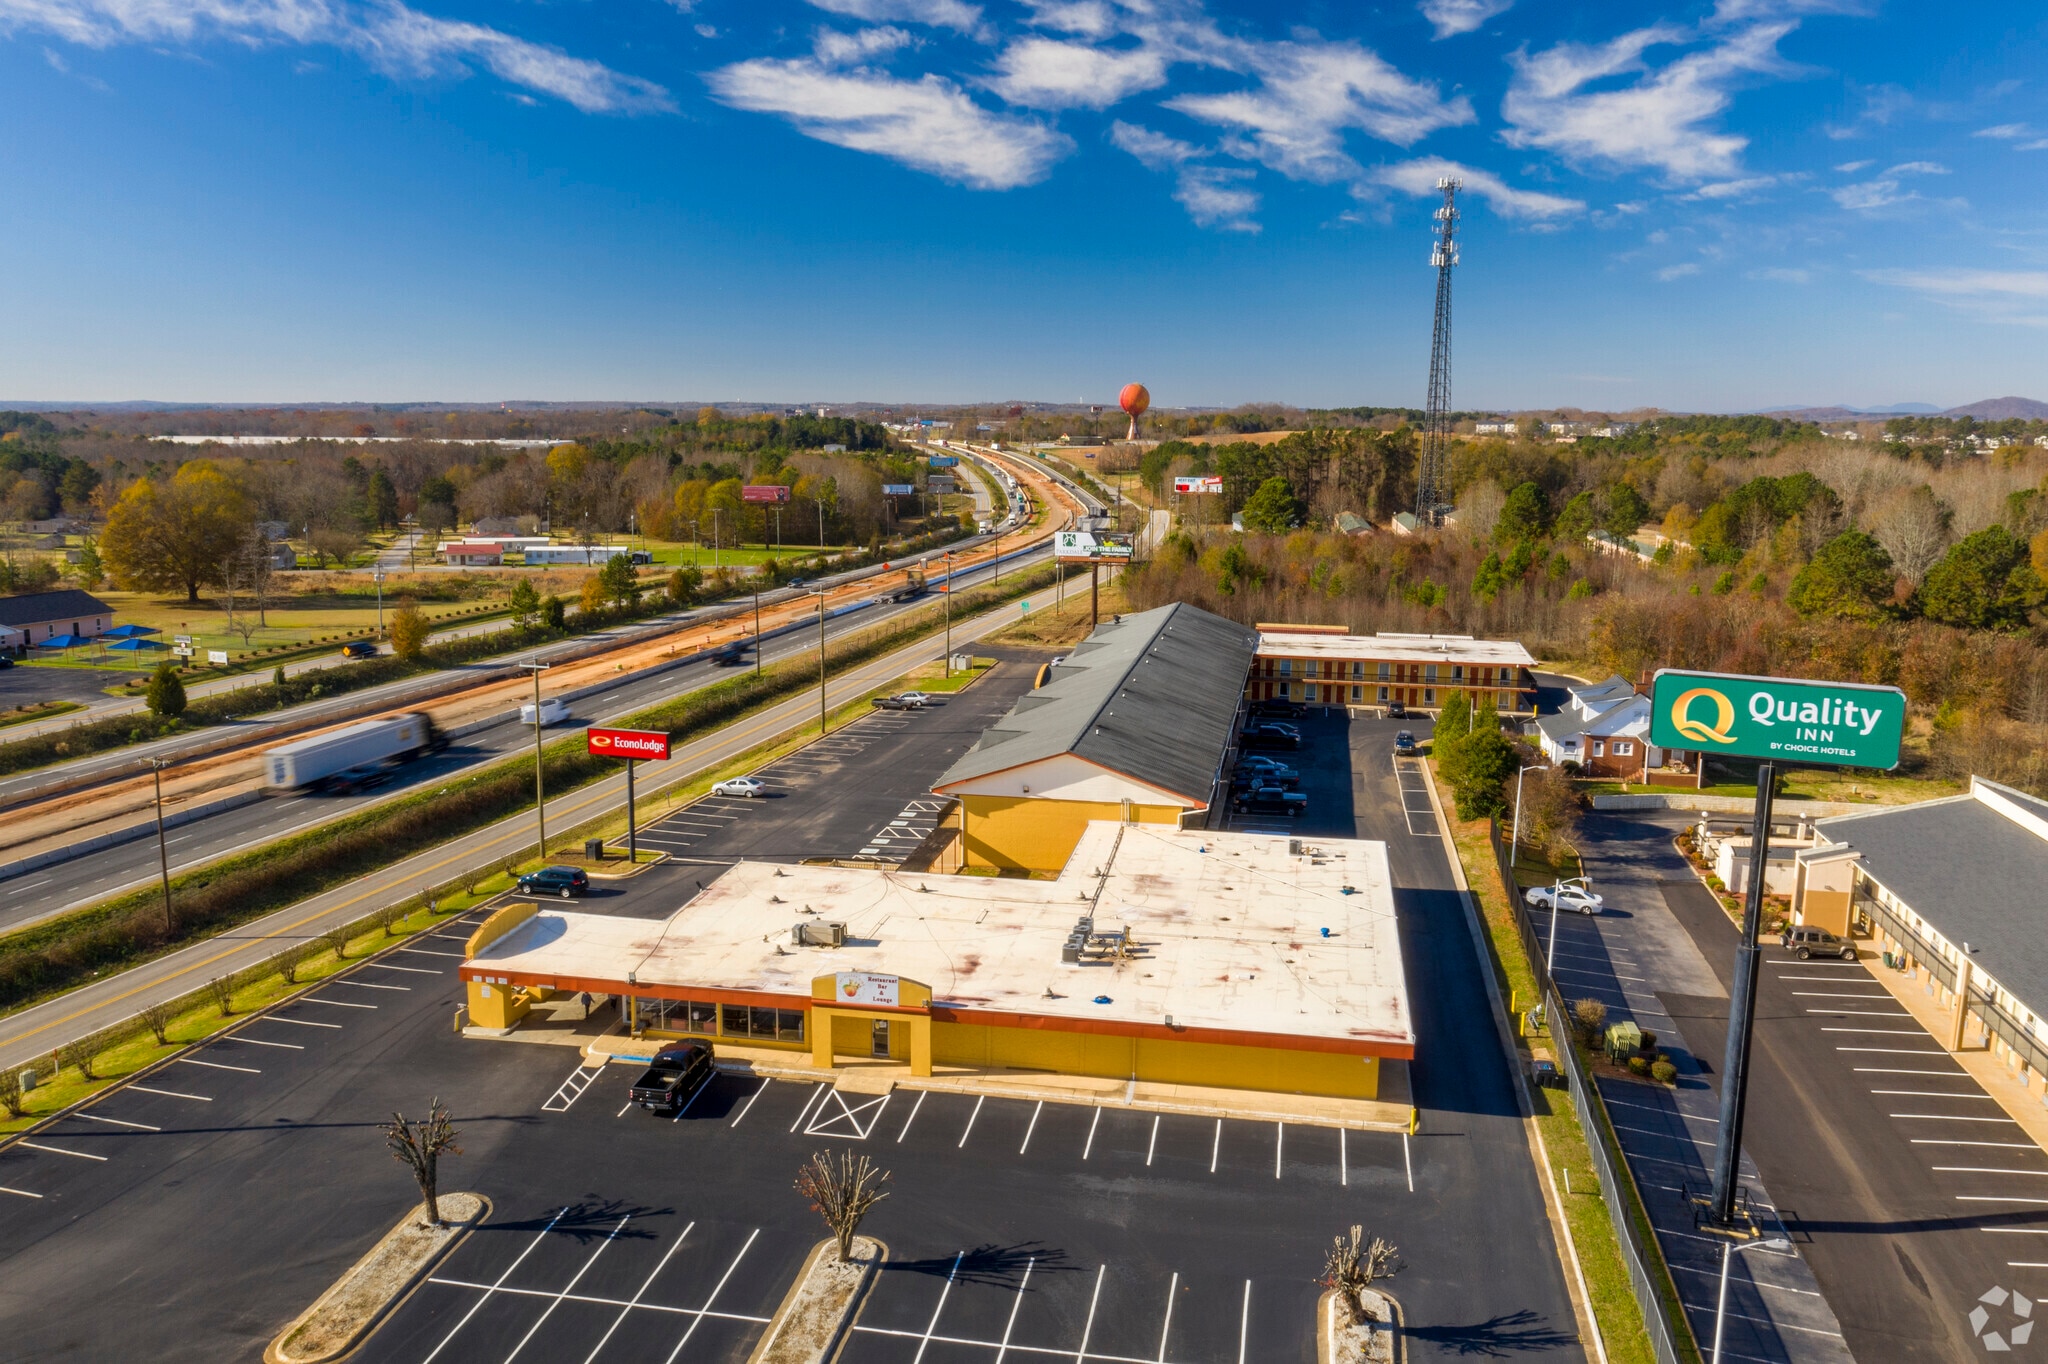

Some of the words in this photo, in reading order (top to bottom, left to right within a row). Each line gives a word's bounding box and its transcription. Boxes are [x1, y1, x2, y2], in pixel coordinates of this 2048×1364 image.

[1112, 545, 1133, 553] FAMILY
[1749, 692, 1882, 735] Quality
[1796, 727, 1833, 742] INN
[614, 736, 664, 753] EconoLodge
[1770, 742, 1782, 750] BY
[1784, 743, 1818, 753] CHOICE
[1820, 747, 1856, 757] HOTELS
[868, 976, 898, 984] Restaurant
[872, 996, 892, 1004] Lounge
